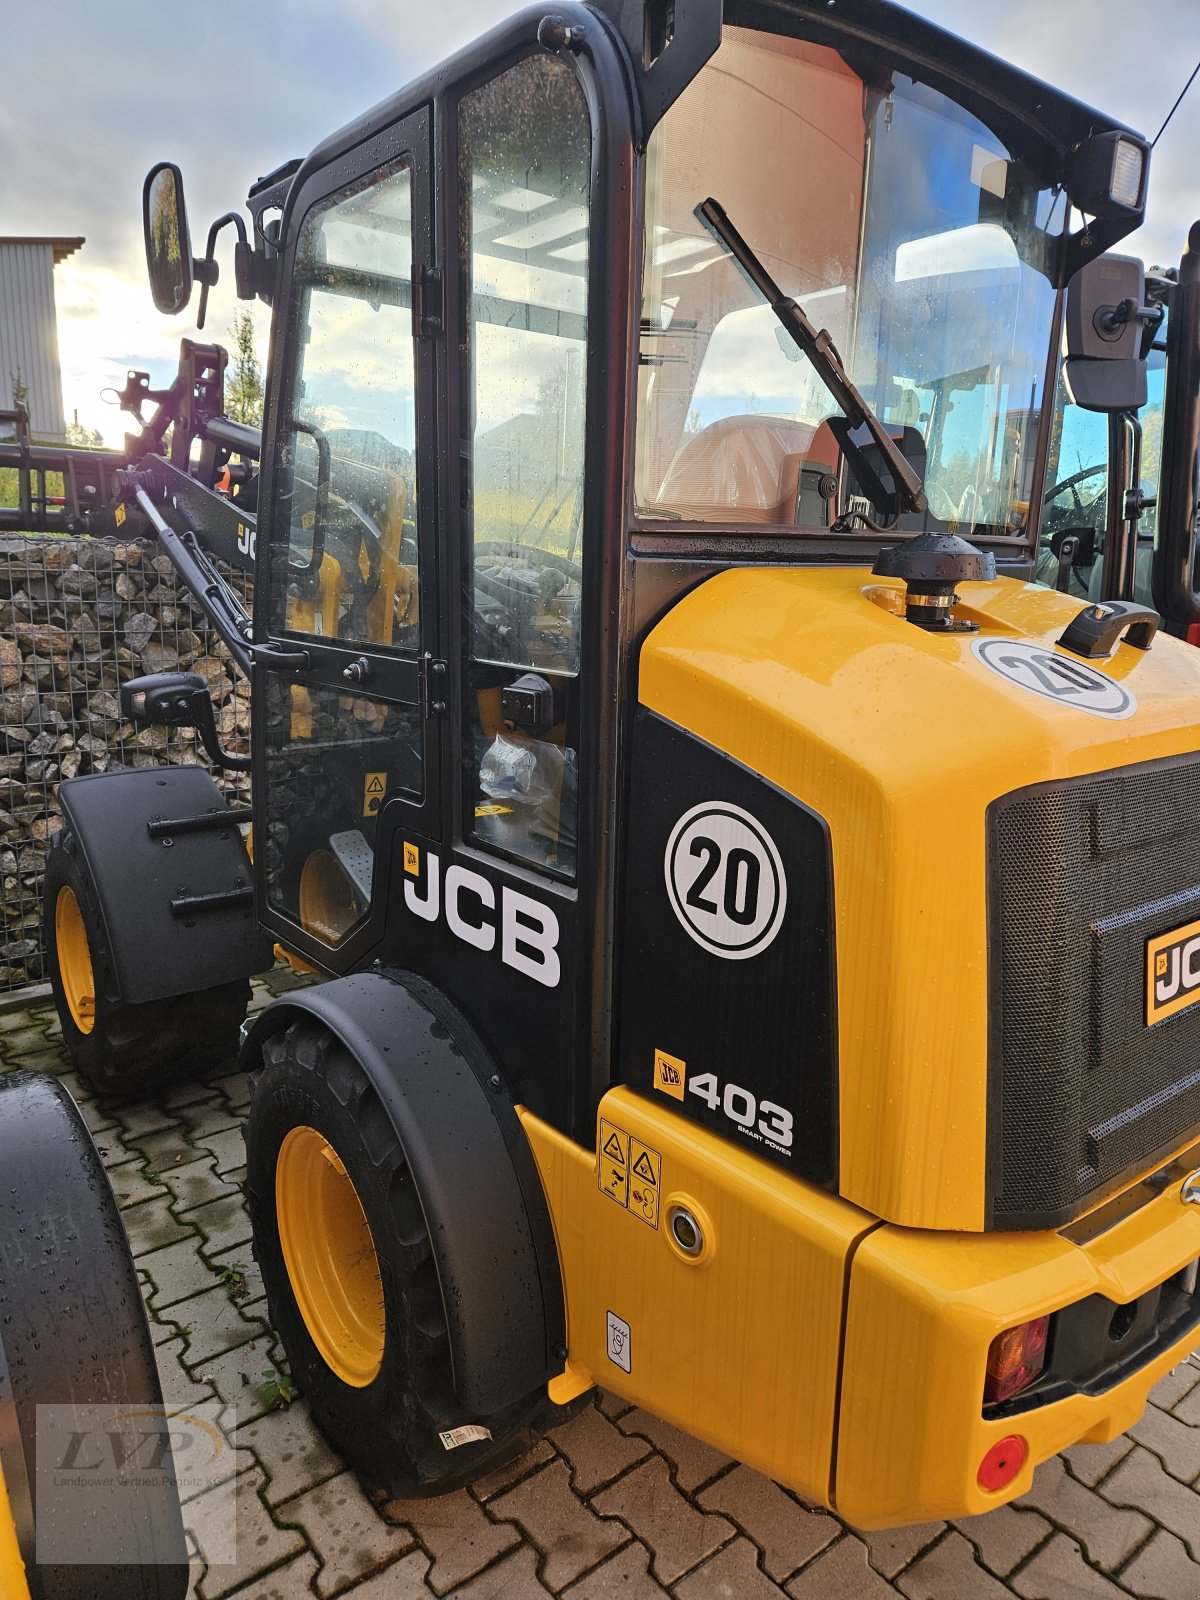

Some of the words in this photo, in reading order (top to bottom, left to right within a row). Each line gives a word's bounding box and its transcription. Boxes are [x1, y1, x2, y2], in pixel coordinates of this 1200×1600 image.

[998, 654, 1107, 696] 20
[686, 835, 761, 926] 20
[403, 851, 561, 988] JCB
[661, 1062, 681, 1084] JCB
[688, 1072, 794, 1147] 403
[737, 1125, 764, 1142] SMART
[764, 1139, 792, 1157] POWER
